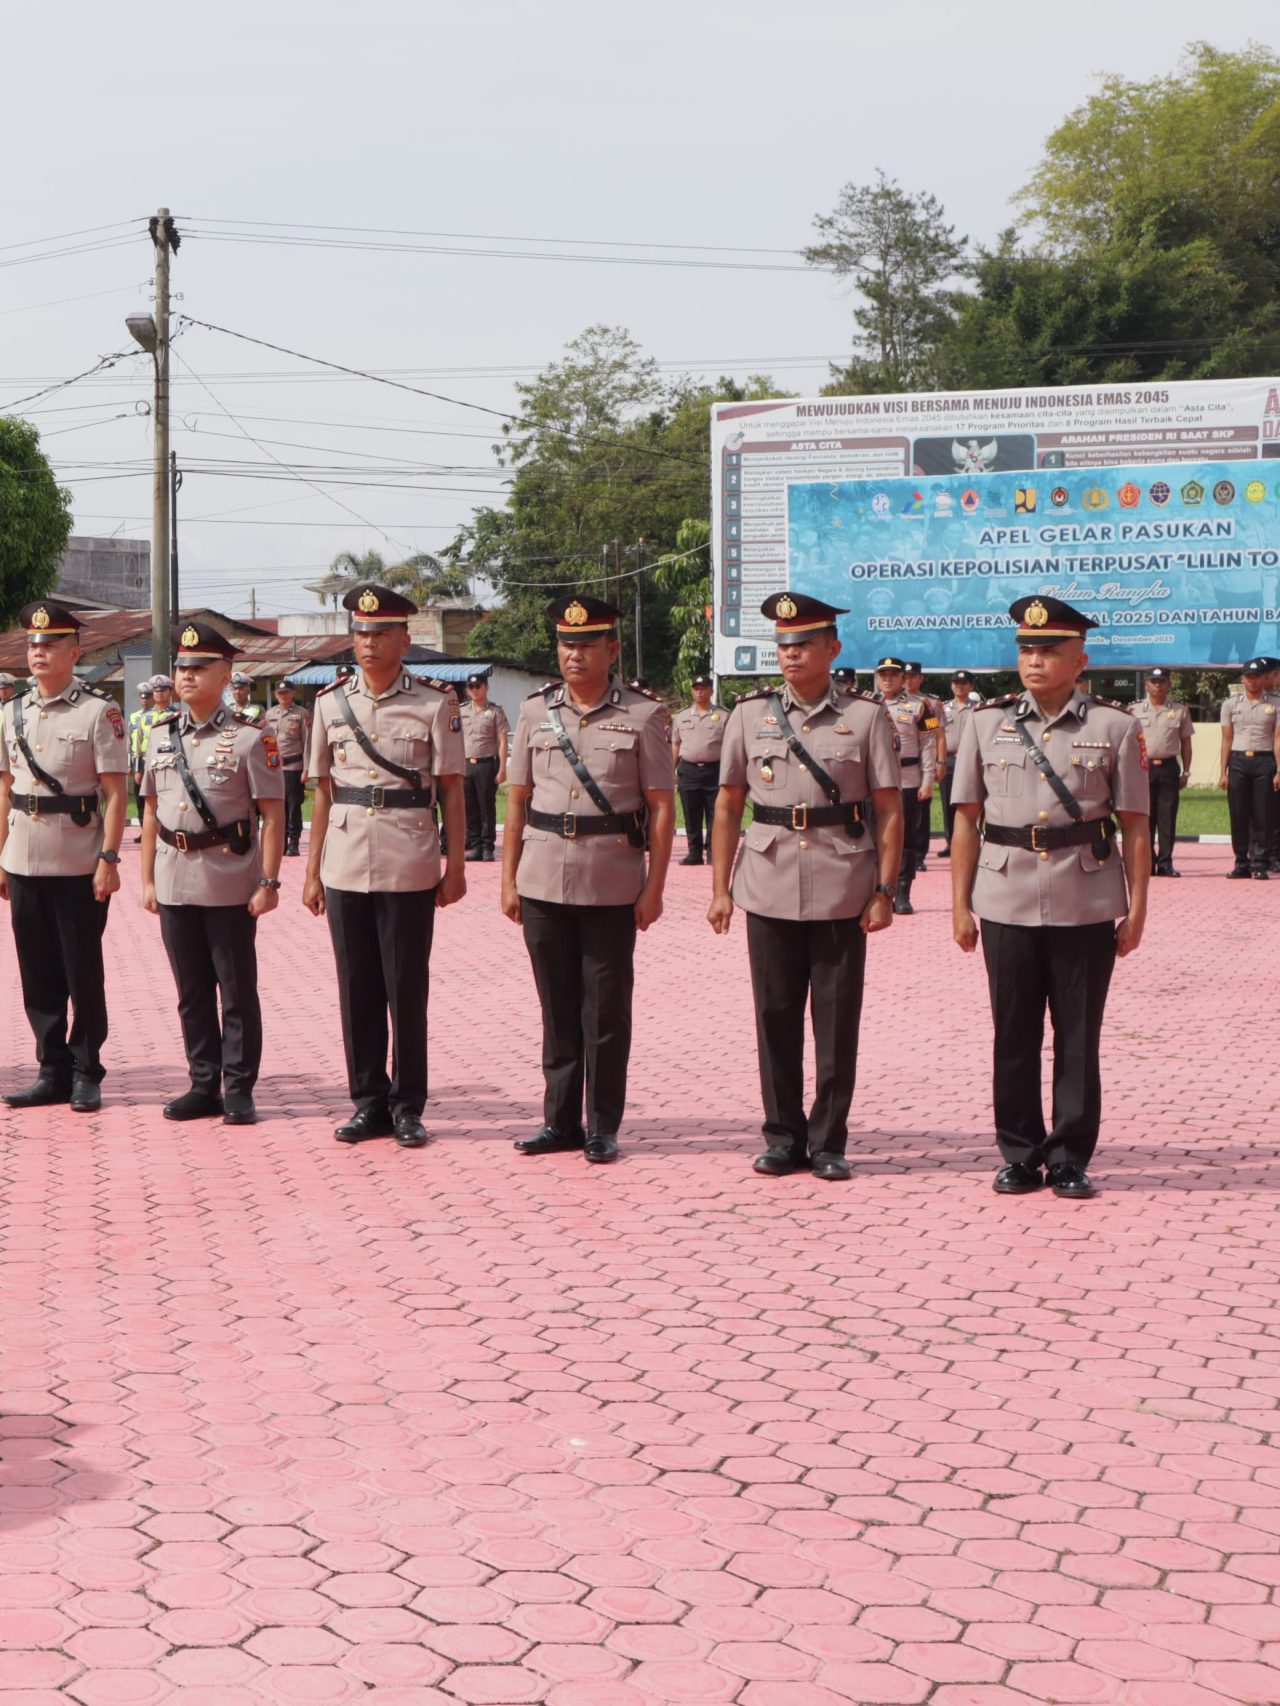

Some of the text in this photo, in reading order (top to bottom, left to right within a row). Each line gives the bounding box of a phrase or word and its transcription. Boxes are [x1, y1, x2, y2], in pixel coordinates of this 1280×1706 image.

[796, 390, 1169, 418] MEWUJUDKAN VISI BERSAMA MENUJU INDONESIA EMAS 2045
[1264, 388, 1280, 414] A
[739, 421, 761, 429] Untuk
[764, 420, 807, 429] menggapai
[824, 418, 854, 427] Menuju
[856, 416, 894, 425] Indonesia
[896, 415, 920, 423] Emas
[921, 414, 941, 422] 2045
[943, 411, 988, 421] dibutuhkan
[990, 410, 1035, 420] kesamaan
[1037, 409, 1072, 418] cita-cita
[1075, 409, 1096, 419] yang
[1098, 406, 1148, 416] disimpulkan
[1150, 405, 1177, 414] dalam
[765, 430, 801, 438] sehingga
[803, 430, 832, 438] mampu
[895, 423, 953, 433] melaksanakan
[955, 423, 965, 431] 17
[967, 422, 1005, 432] Program
[1007, 420, 1045, 430] Prioritas
[1047, 419, 1064, 428] dan
[1073, 418, 1112, 428] Program
[1114, 417, 1138, 425] Hasil
[1140, 415, 1173, 424] Terbaik
[1175, 414, 1203, 424] Cepat
[1060, 430, 1235, 444] ARAHAN PRESIDEN RI SAAT SKP
[790, 441, 843, 451] ASTA CITA
[731, 456, 737, 464] 1
[1049, 454, 1056, 464] 1
[730, 475, 737, 484] 2
[730, 500, 737, 510] 3
[730, 526, 737, 535] 4
[979, 521, 1232, 545] APEL GELAR PASUKAN
[851, 562, 934, 580] OPERASI
[940, 558, 1060, 577] KEPOLISIAN
[1066, 554, 1174, 572] TERPUSAT
[1247, 550, 1280, 567] TO
[731, 591, 737, 600] 7
[1037, 579, 1171, 605] Dalam Rangka
[869, 615, 961, 629] PELAYANAN
[966, 614, 1020, 628] PERAY
[1114, 612, 1153, 624] 2025
[1158, 610, 1196, 623] DAN
[1202, 609, 1259, 622] TAHUN
[1111, 634, 1153, 644] Desember
[1154, 634, 1174, 643] 2025
